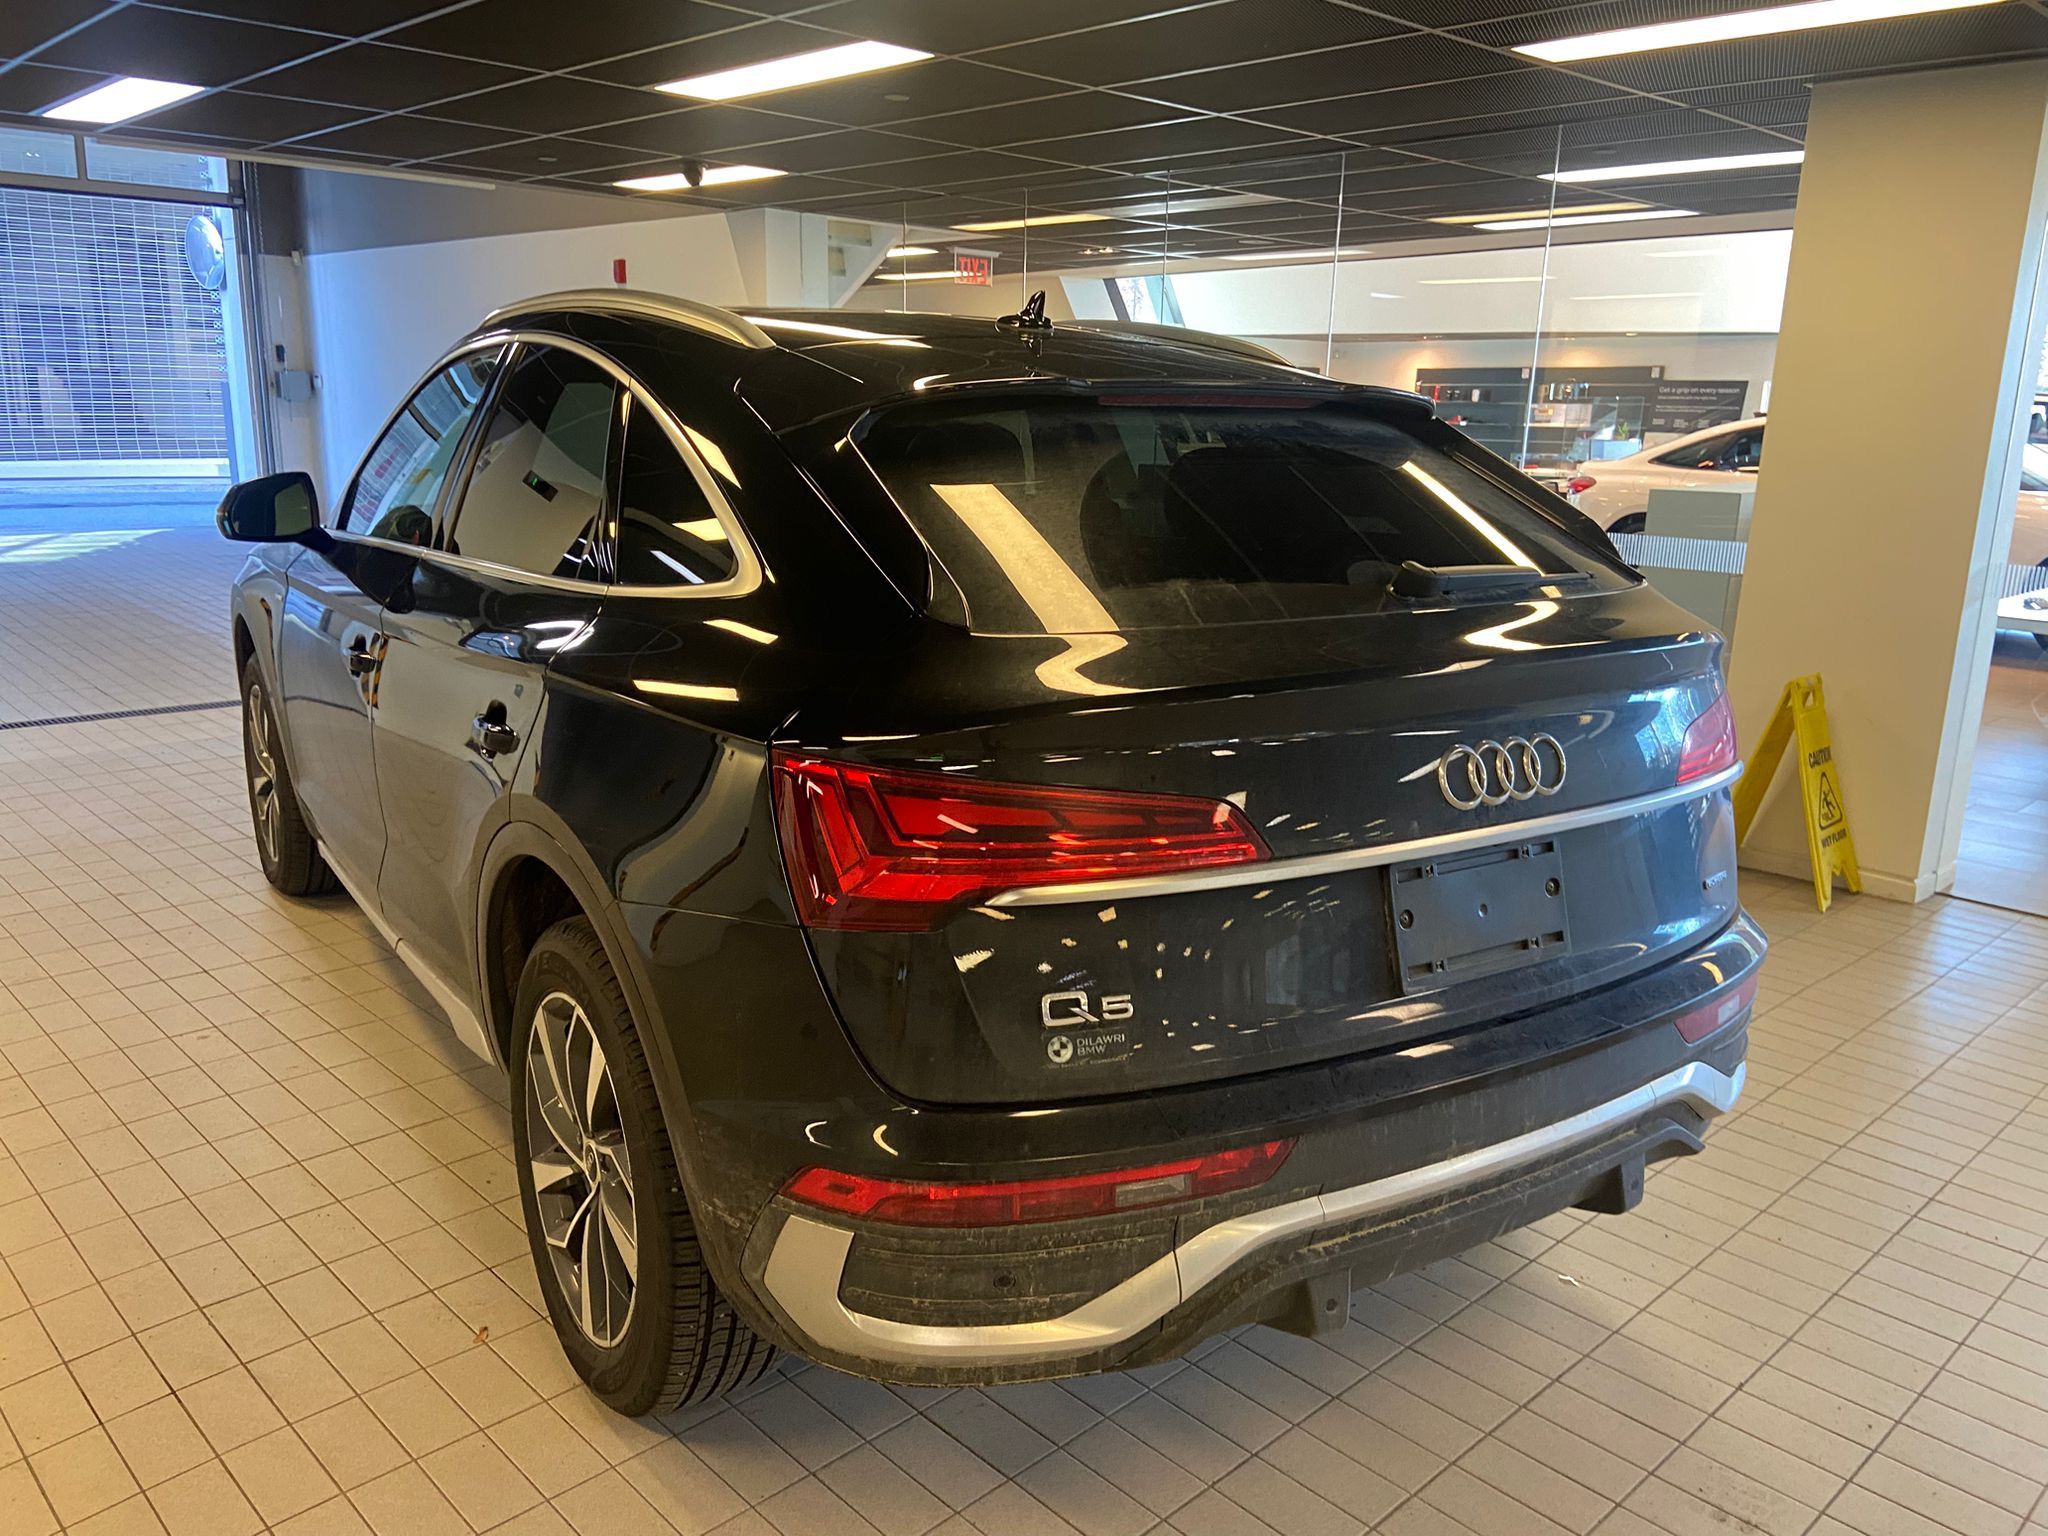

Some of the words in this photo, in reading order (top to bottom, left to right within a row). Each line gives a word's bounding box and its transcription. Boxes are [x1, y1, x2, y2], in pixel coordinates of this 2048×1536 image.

[1676, 387, 1689, 395] grip
[1699, 387, 1716, 395] every
[1808, 746, 1832, 769] CAUTION
[1821, 834, 1832, 848] WET
[1832, 827, 1847, 843] FLOOR
[1041, 990, 1134, 1027] Q5
[1076, 1033, 1125, 1047] DILAWRI
[1077, 1045, 1106, 1057] BMW
